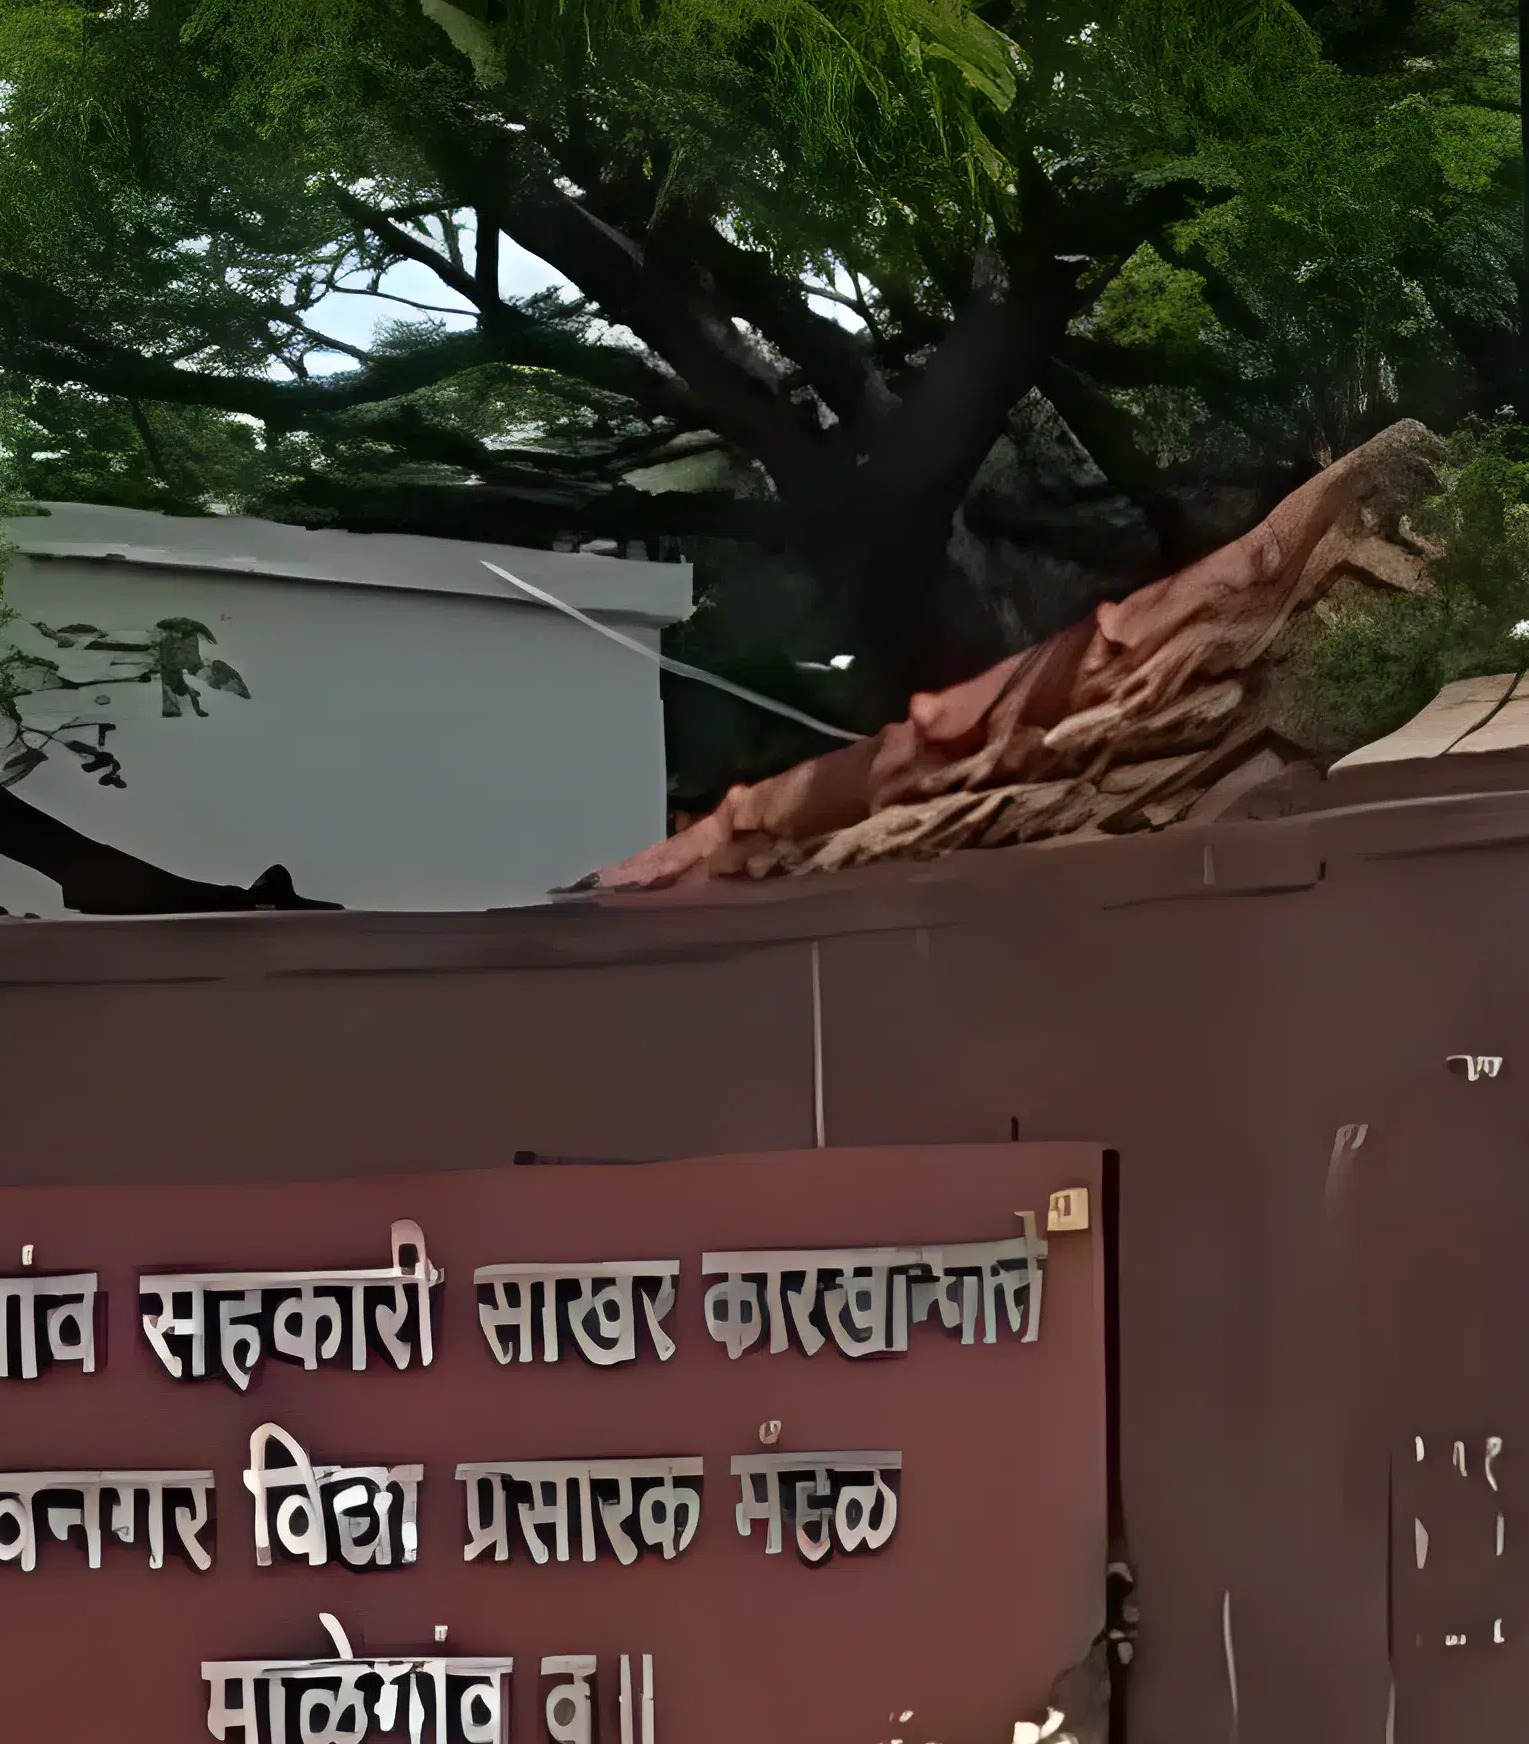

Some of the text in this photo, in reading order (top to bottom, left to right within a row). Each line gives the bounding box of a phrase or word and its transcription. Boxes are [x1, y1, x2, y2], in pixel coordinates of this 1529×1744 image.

[139, 1219, 444, 1391] सहकारी
[474, 1259, 680, 1365] साखर
[455, 1457, 703, 1565] प्रसारक
